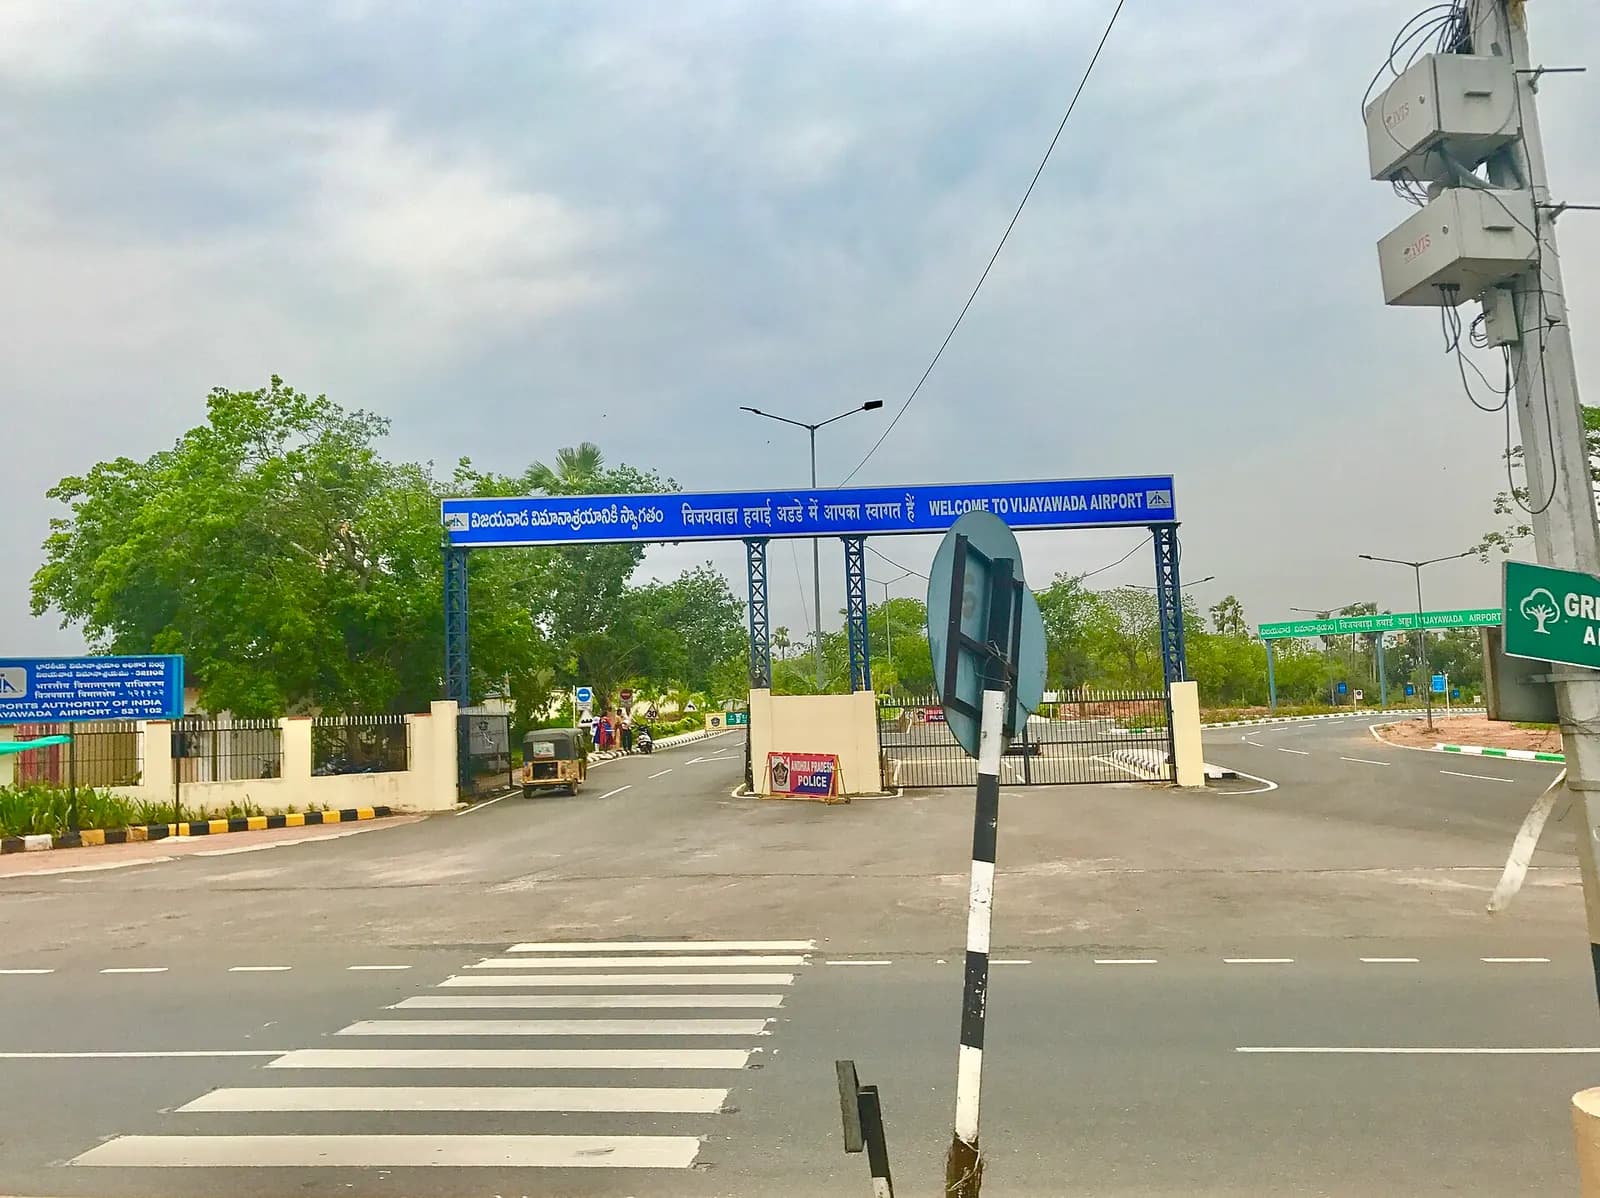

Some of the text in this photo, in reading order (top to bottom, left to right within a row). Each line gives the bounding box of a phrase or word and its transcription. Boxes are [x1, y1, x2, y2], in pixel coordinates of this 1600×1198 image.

[929, 492, 1143, 516] WELCOME TO VIJAYAWADA AIRPORT
[471, 504, 664, 531] విజయవాడ విమానాశ్రయానికి స్వాగతం
[681, 502, 738, 526] विजयवाडा
[743, 498, 772, 528] हवाई
[808, 497, 819, 521] में
[824, 503, 860, 521] आपका
[865, 502, 901, 521] स्वागत
[1469, 612, 1501, 622] AIRPORT
[1583, 626, 1600, 646] A
[41, 701, 109, 709] AUTHORITY
[131, 699, 162, 707] INDIA
[59, 708, 111, 717] AIRPORT
[798, 775, 827, 787] POLICE
